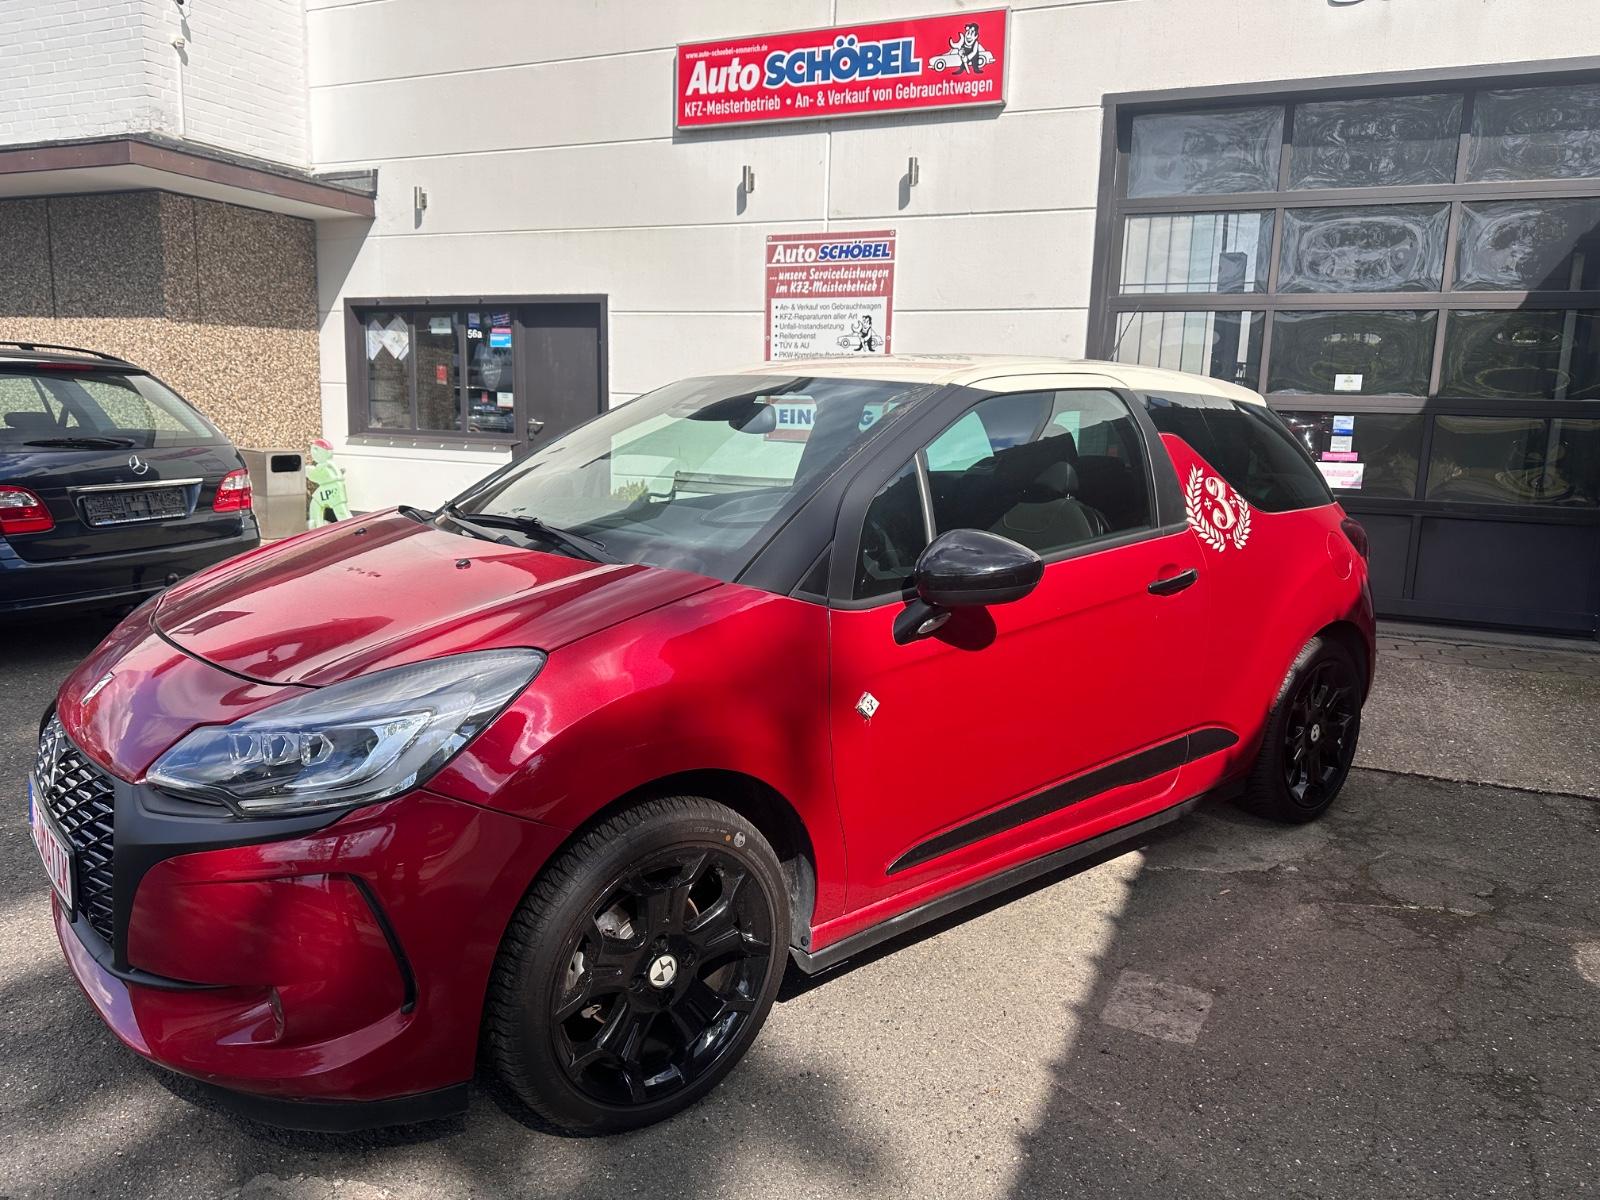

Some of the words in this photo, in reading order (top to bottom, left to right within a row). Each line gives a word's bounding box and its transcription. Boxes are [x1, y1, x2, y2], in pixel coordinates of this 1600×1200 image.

[685, 44, 768, 59] www.auto-schoebel-emmerich.de
[685, 57, 760, 96] Auto
[763, 35, 921, 88] SCHÖBEL
[684, 94, 781, 117] KFZ-Meisterbetrieb
[795, 91, 814, 108] An-
[816, 90, 825, 107] &
[827, 86, 870, 106] Verkauf
[872, 86, 892, 102] von
[895, 79, 993, 100] Gebrauchtwagen
[772, 244, 816, 263] Auto
[818, 240, 890, 260] SCHÖBEL
[809, 267, 889, 283] Serviceleistungen
[776, 282, 788, 294] im
[790, 280, 878, 294] KFZ-Meisterbetrieb
[796, 303, 819, 311] Verkauf
[831, 302, 882, 312] Gebrauchtwagen
[779, 313, 832, 322] KFZ-Reparaturen
[779, 322, 845, 331] Unfall-Instandsetzung
[467, 329, 483, 339] 56a
[779, 332, 816, 340] Reifendienst
[778, 341, 793, 350] TÜV
[1205, 476, 1237, 529] 3
